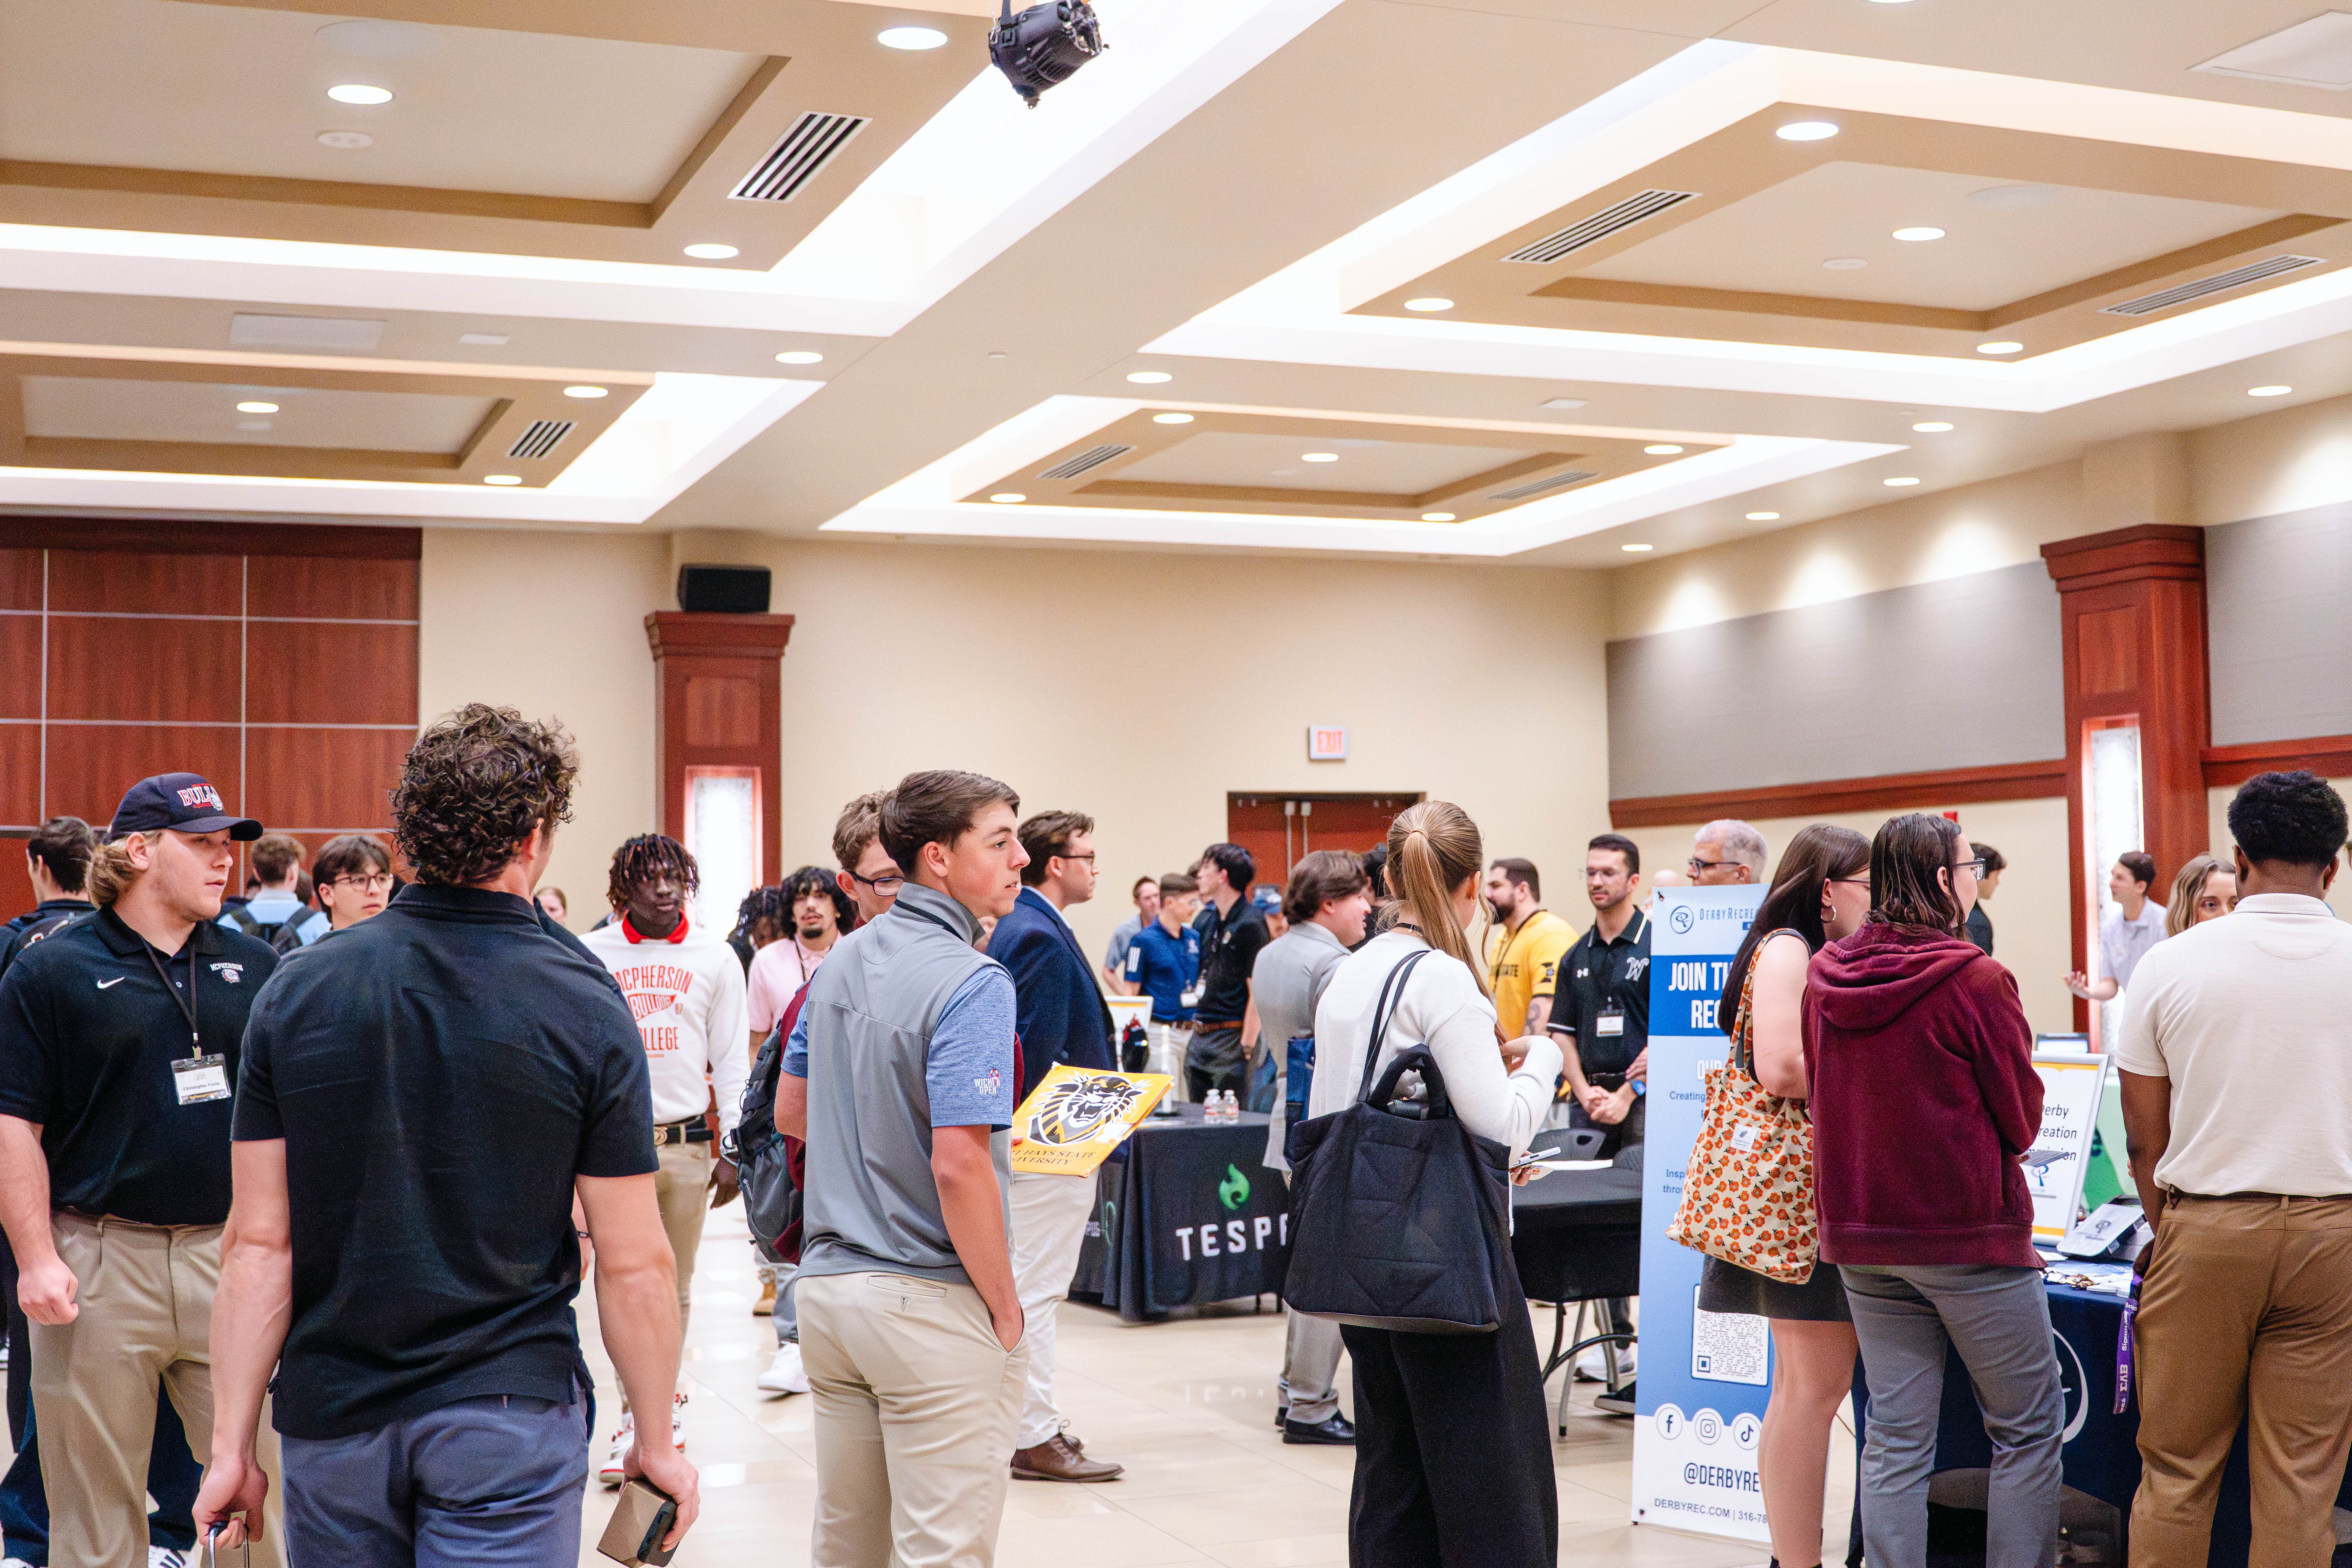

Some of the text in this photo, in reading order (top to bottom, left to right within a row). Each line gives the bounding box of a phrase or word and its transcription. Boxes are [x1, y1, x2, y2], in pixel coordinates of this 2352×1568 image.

[1316, 730, 1343, 753] EXIT
[1699, 907, 1755, 920] DERBYRECRE
[1668, 962, 1707, 991] JOIN
[638, 1027, 679, 1051] LLEGE
[974, 1077, 1000, 1087] WICHITA
[979, 1086, 997, 1094] OPEN
[1669, 1090, 1706, 1102] Creating
[2042, 1104, 2069, 1119] erby
[1663, 1184, 1682, 1194] thro
[1654, 1498, 1730, 1518] DERBYREC.COM
